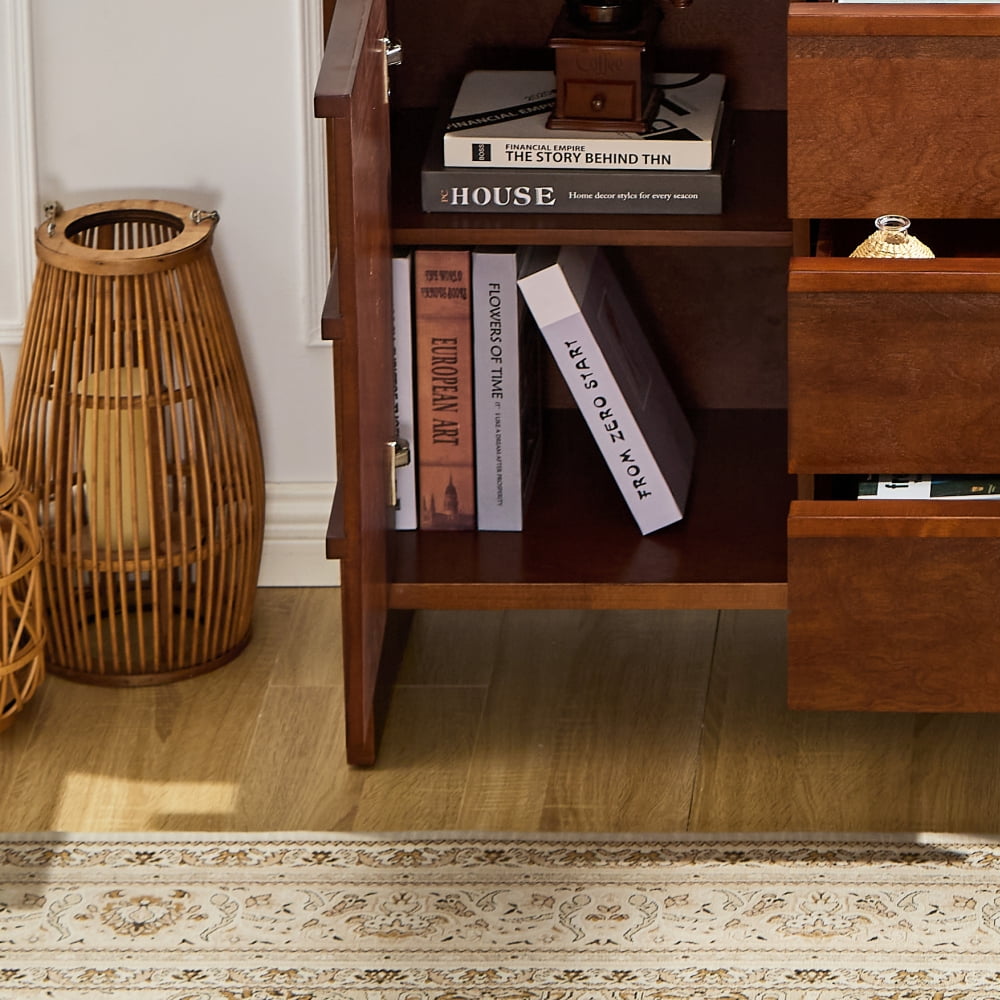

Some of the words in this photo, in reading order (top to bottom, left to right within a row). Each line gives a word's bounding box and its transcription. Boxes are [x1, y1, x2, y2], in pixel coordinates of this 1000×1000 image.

[505, 143, 552, 151] FINANCIAL
[505, 151, 533, 162] THE
[536, 151, 582, 164] STORY
[585, 153, 639, 165] BEHIND
[642, 154, 672, 166] THN
[450, 186, 557, 206] HOUSE
[568, 191, 593, 200] Home
[594, 191, 616, 200] decor
[639, 191, 650, 200] for
[652, 193, 672, 201] every
[488, 283, 502, 343] FLOWERS
[490, 345, 503, 364] OF
[564, 340, 598, 389] START
[431, 337, 459, 413] EUROPEAN
[491, 367, 504, 400] TIME
[432, 418, 460, 446] ART
[593, 396, 625, 443] ZERO
[619, 448, 652, 501] FROM
